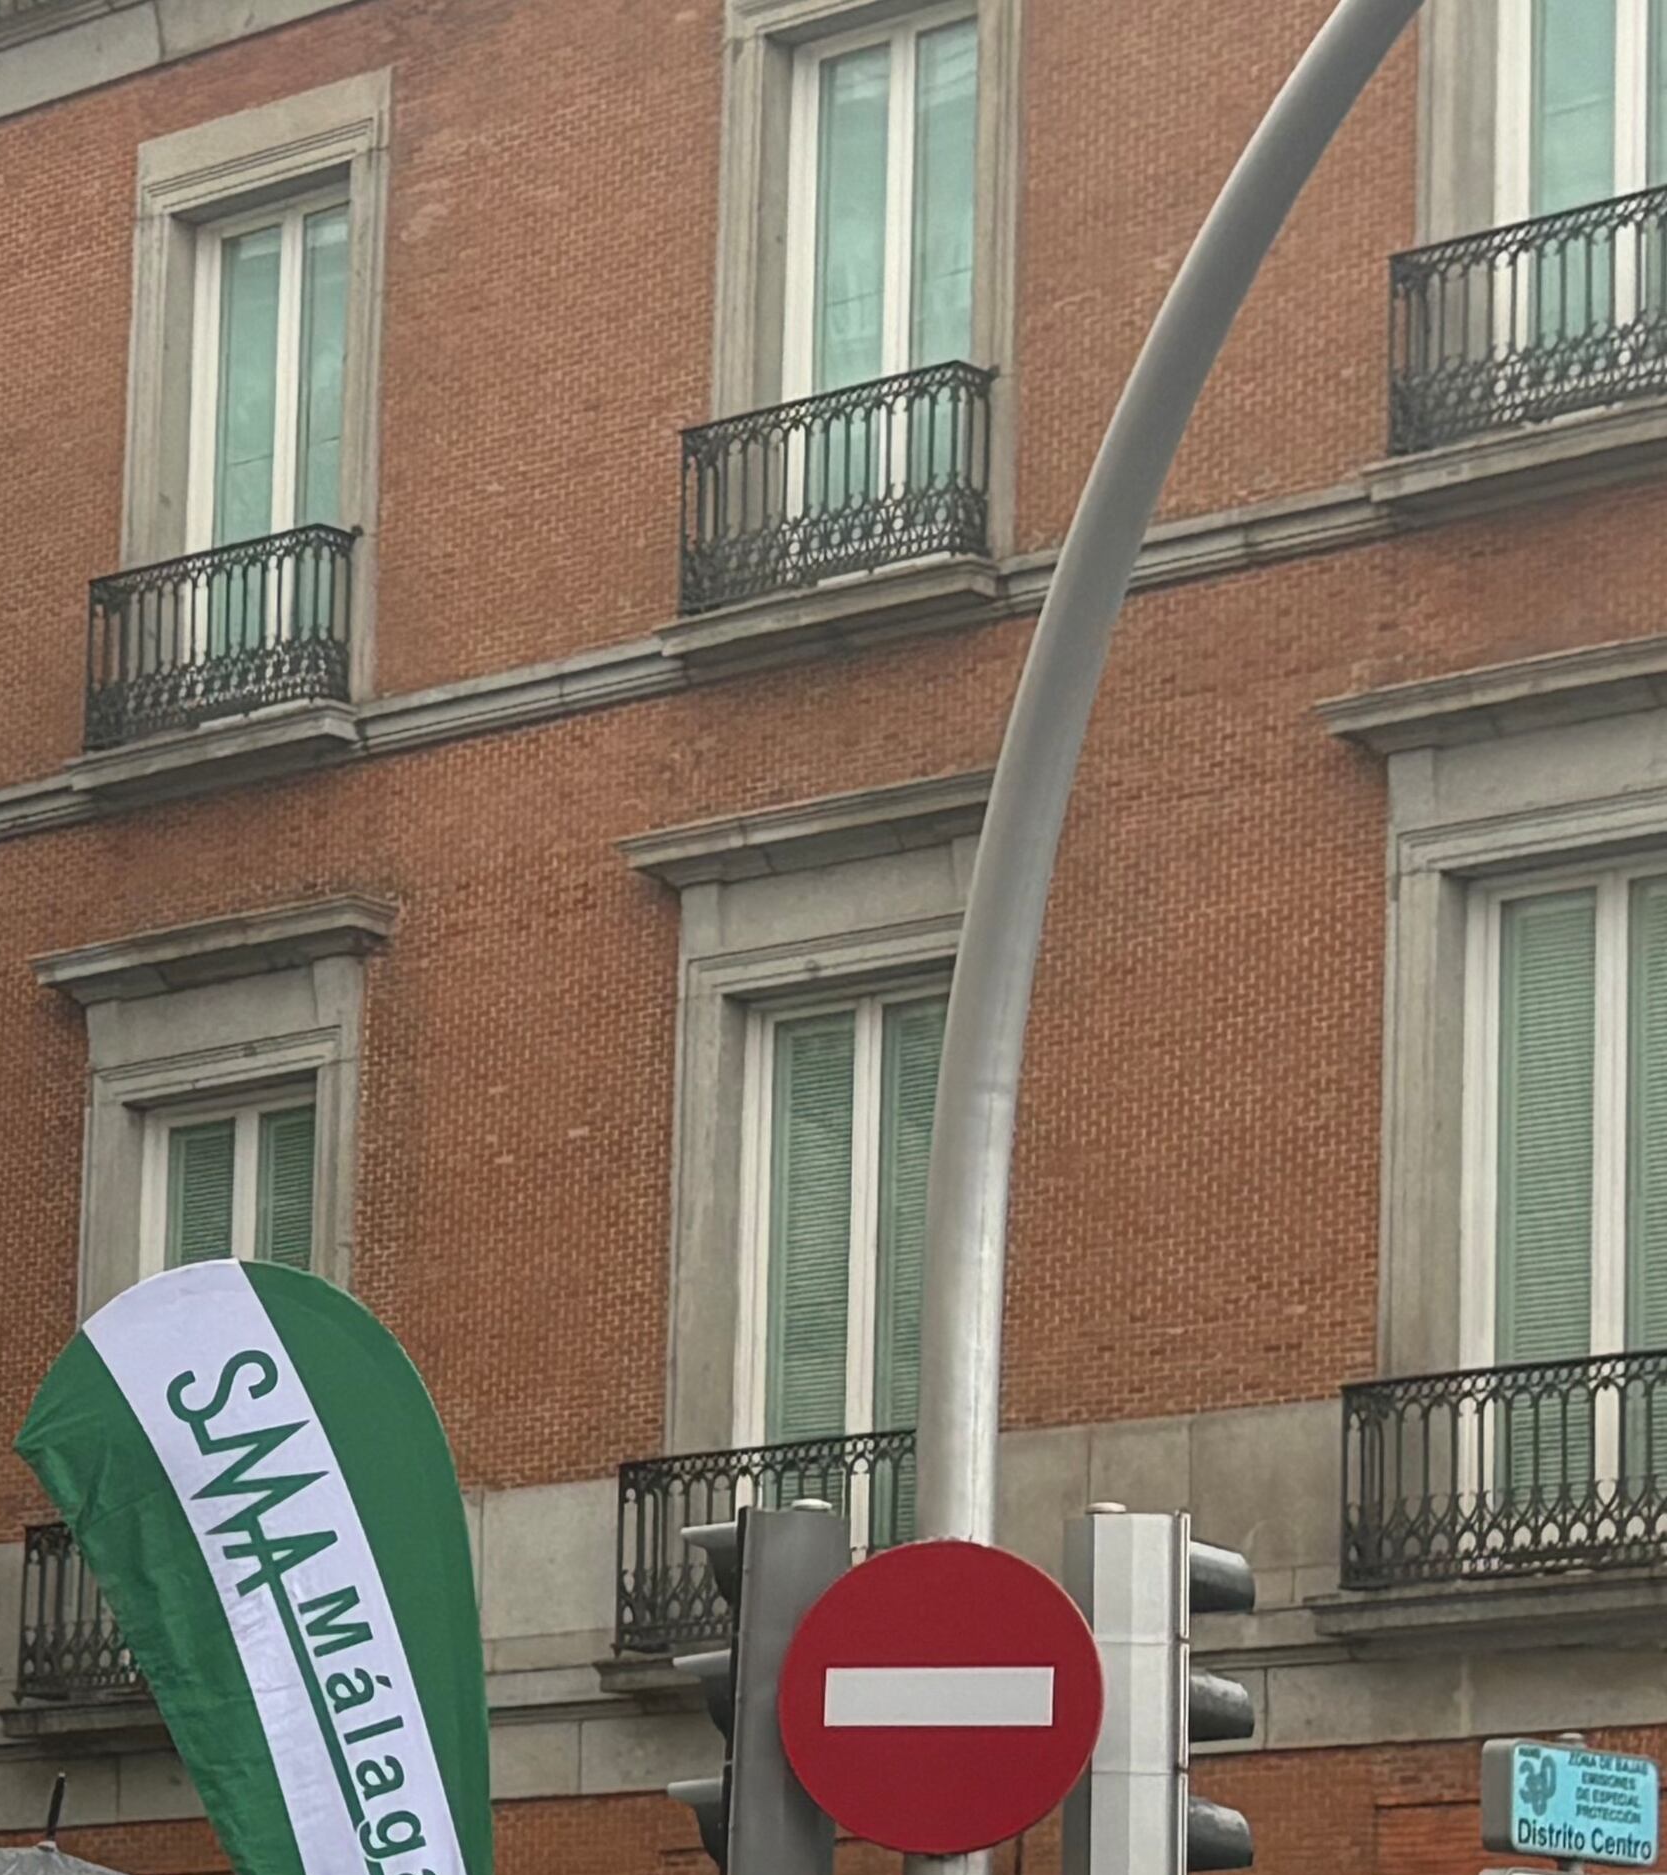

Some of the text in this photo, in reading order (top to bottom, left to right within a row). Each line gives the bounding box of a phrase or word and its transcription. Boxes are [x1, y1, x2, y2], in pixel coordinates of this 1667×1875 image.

[166, 1348, 338, 1597] SMA
[1518, 1818, 1652, 1860] Distrito Centro
